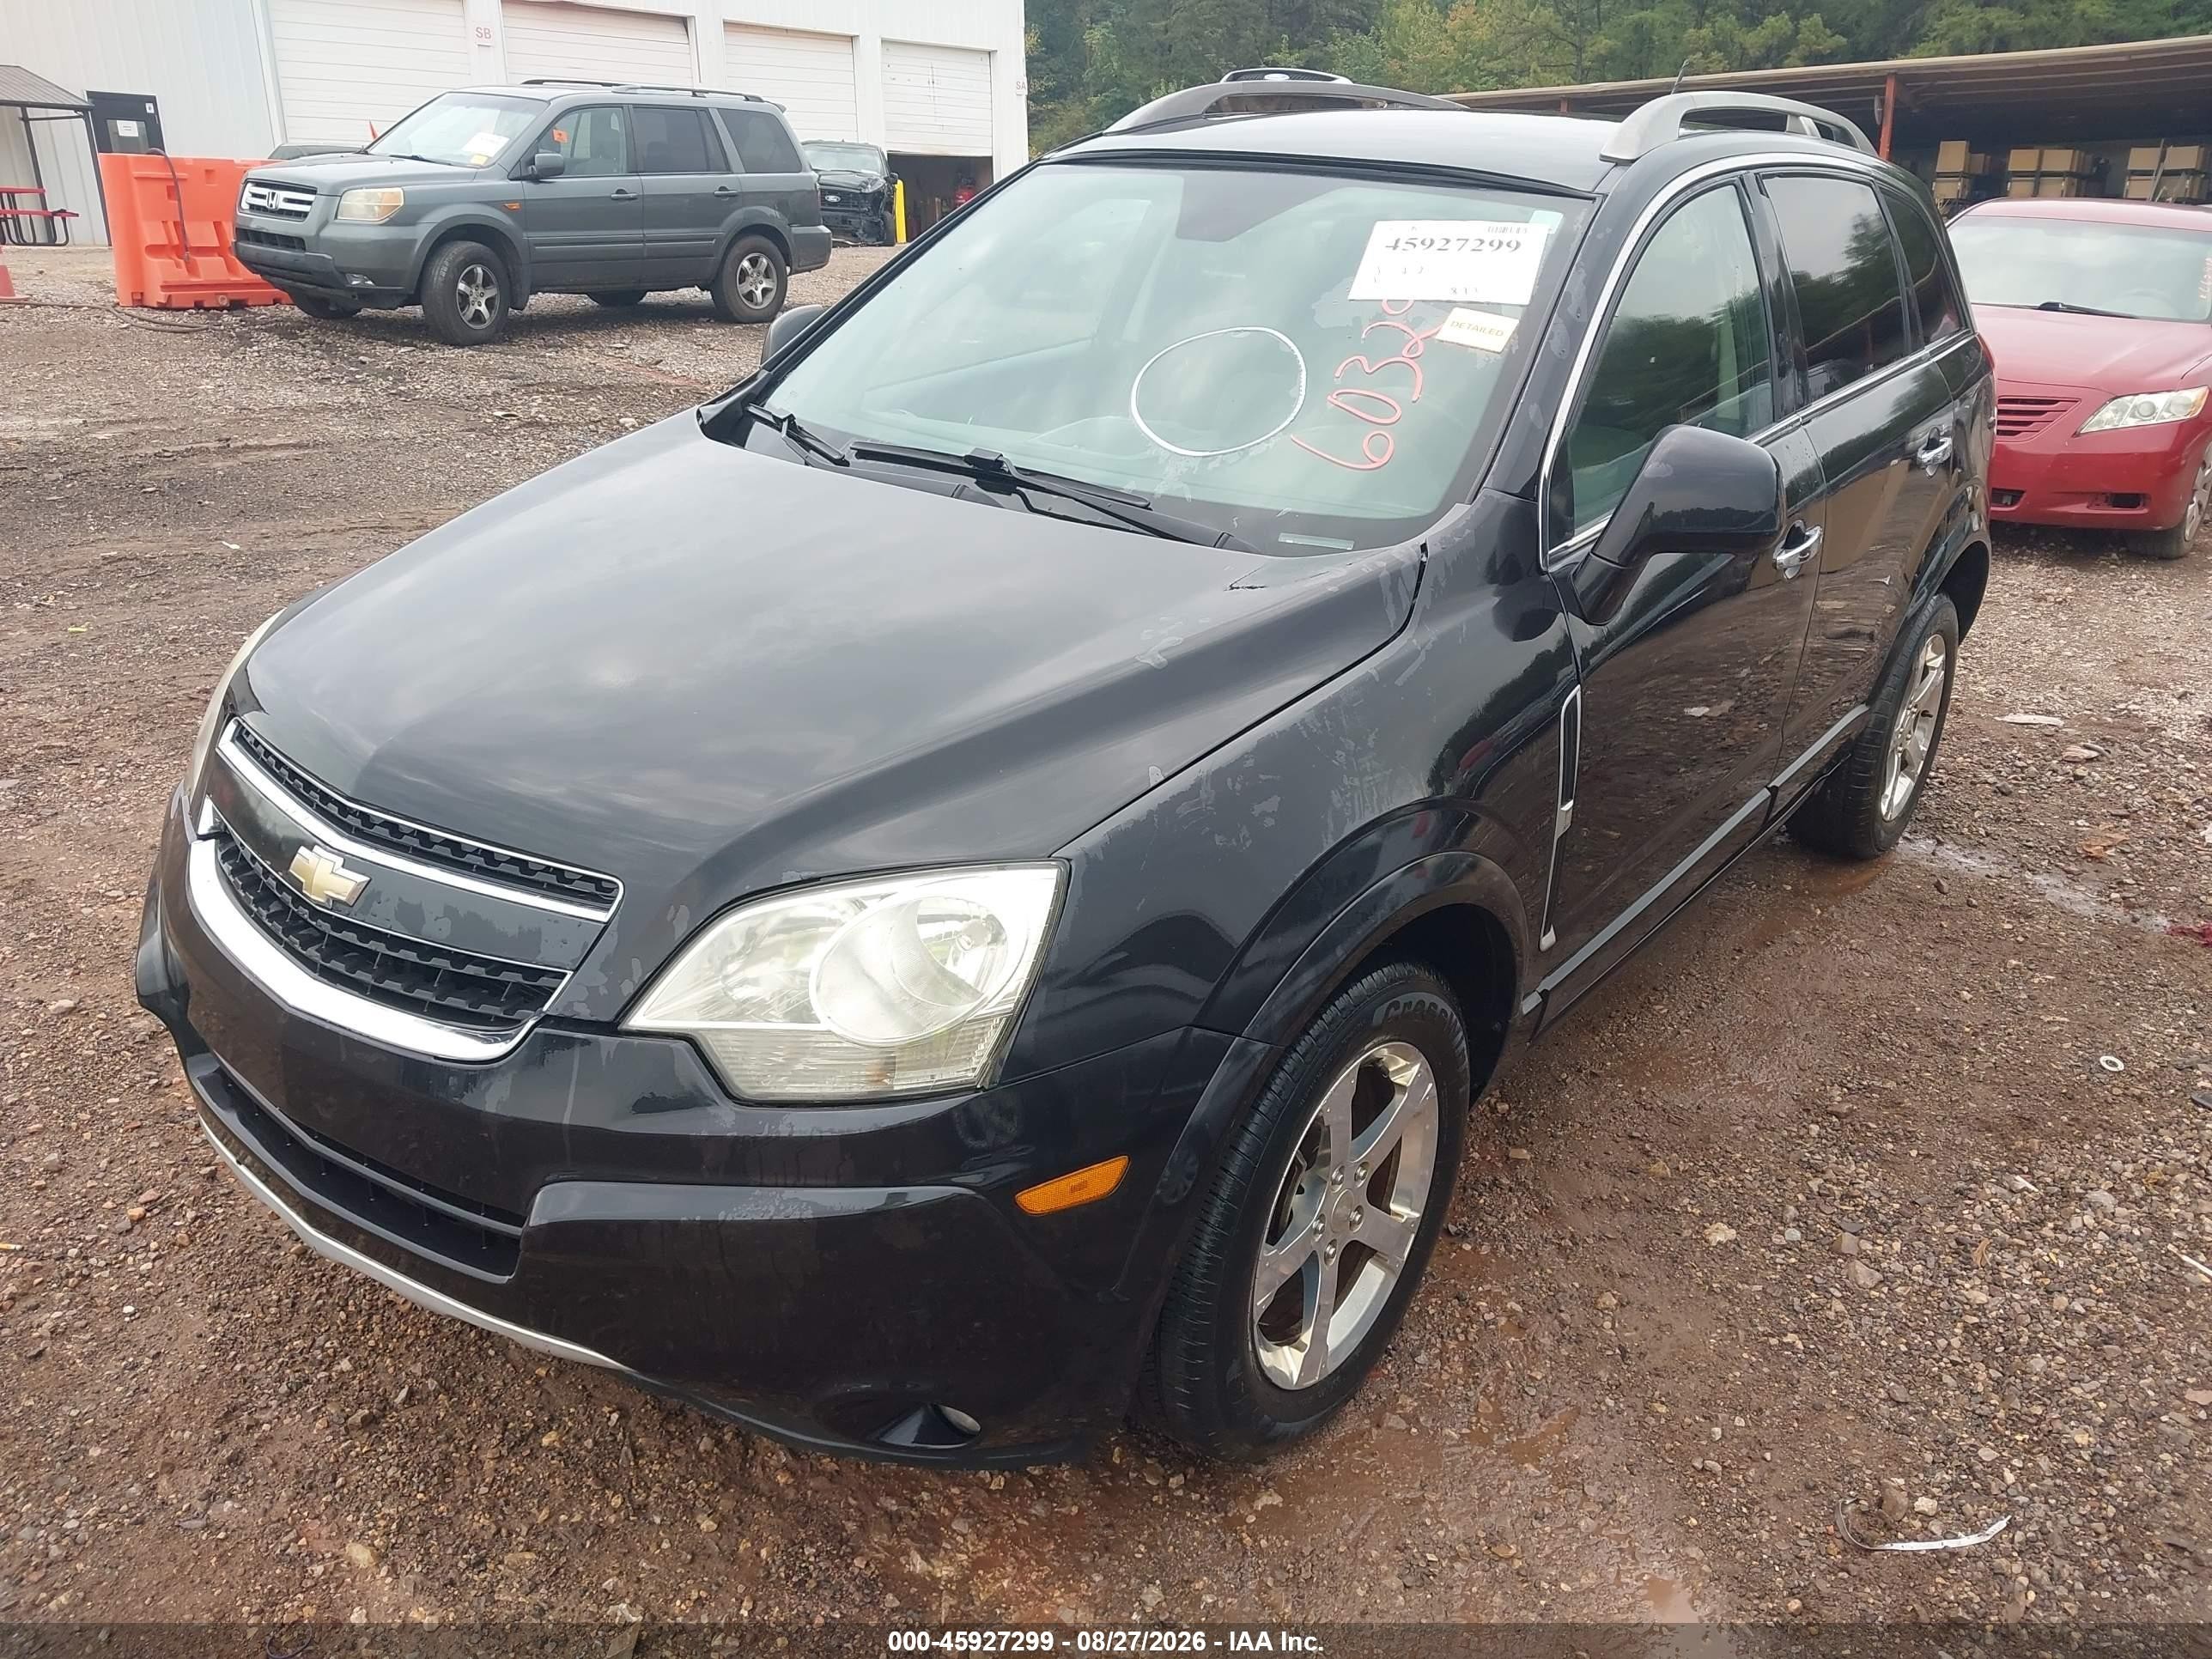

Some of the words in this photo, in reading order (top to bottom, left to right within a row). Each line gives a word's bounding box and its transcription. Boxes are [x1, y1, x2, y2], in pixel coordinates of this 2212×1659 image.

[476, 27, 492, 40] SB
[1016, 81, 1026, 90] SA
[1384, 237, 1522, 252] 45927299
[1449, 320, 1504, 337] DETAILED
